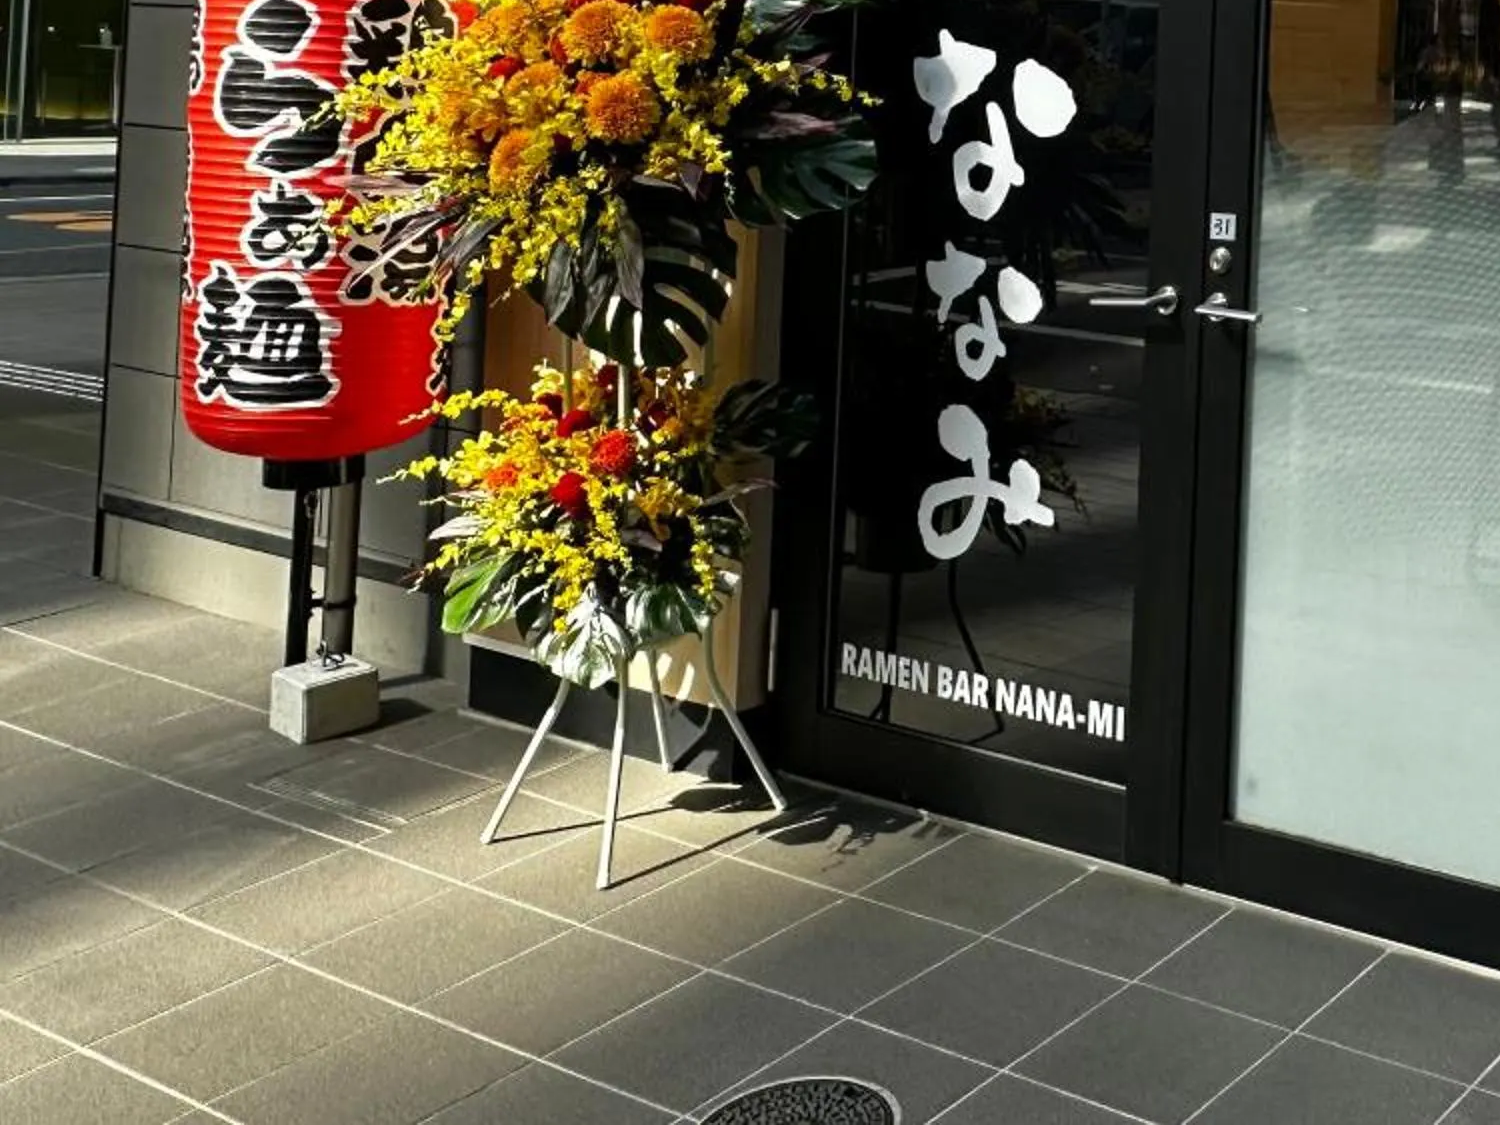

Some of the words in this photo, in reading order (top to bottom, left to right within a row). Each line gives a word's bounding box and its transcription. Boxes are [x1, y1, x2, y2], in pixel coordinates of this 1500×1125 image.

[914, 28, 1077, 560] ななみ
[841, 642, 929, 694] RAMEN
[937, 665, 989, 709] BAR
[995, 678, 1125, 742] NANA-MI
